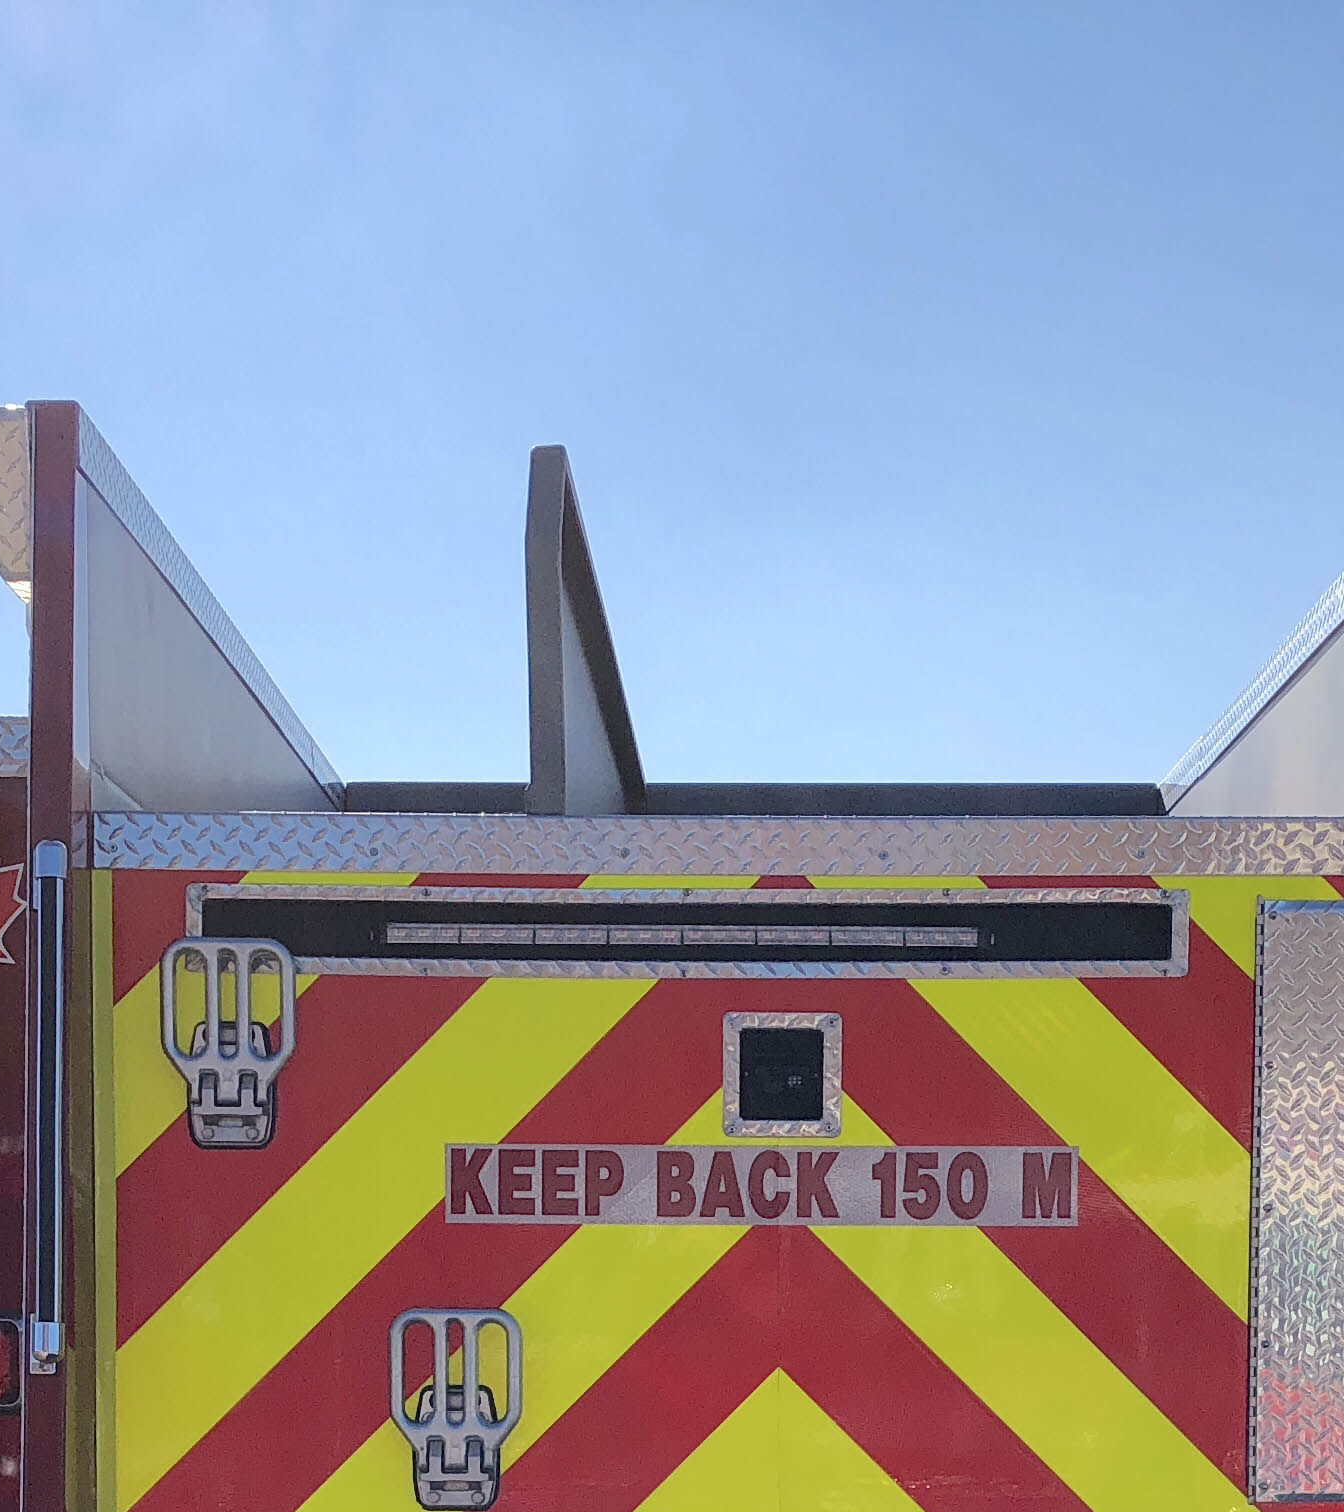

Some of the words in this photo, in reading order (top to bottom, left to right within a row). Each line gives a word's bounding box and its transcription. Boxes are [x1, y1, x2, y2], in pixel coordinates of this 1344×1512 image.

[450, 1147, 625, 1217] KEEP
[656, 1149, 841, 1219] BACK
[871, 1150, 989, 1220] 150
[1021, 1151, 1072, 1219] M
